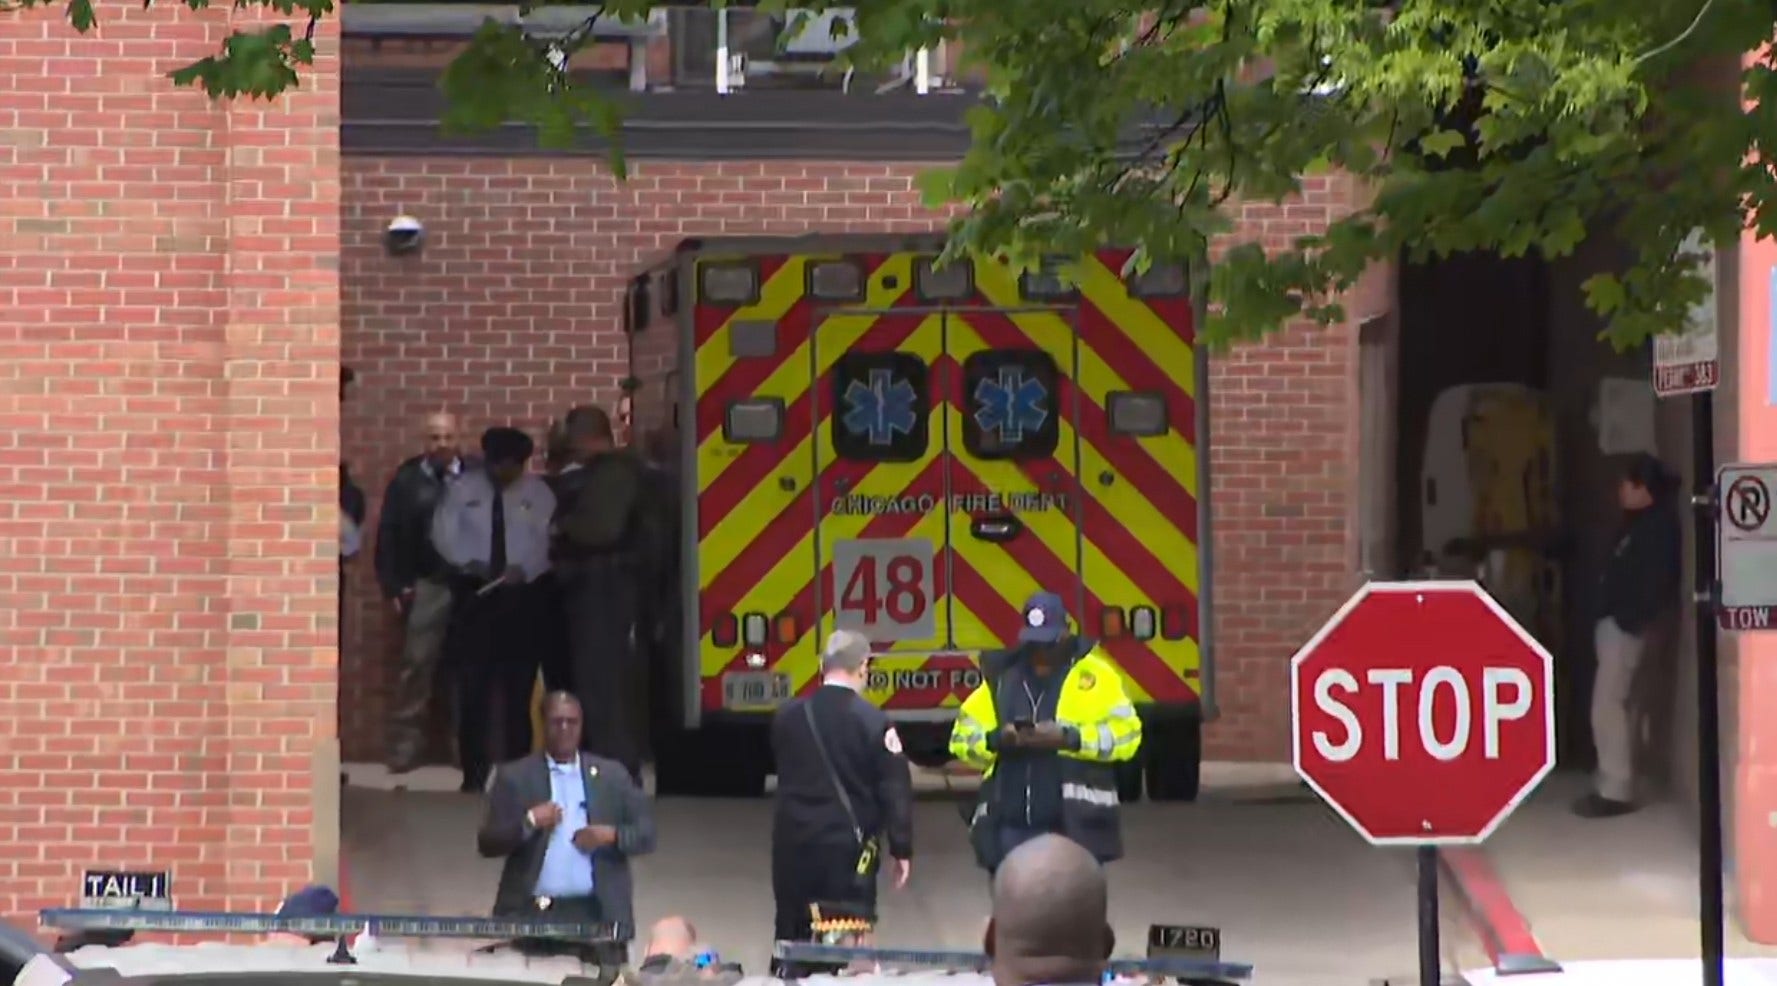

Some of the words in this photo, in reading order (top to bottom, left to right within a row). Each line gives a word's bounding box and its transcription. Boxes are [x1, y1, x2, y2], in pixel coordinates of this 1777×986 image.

[832, 493, 934, 515] CHICAGO
[952, 493, 1000, 513] FIRE
[840, 554, 927, 625] 48
[1726, 607, 1768, 628] TOW
[895, 669, 941, 690] NOT
[1312, 665, 1533, 762] STOP
[87, 875, 144, 897] TAIL
